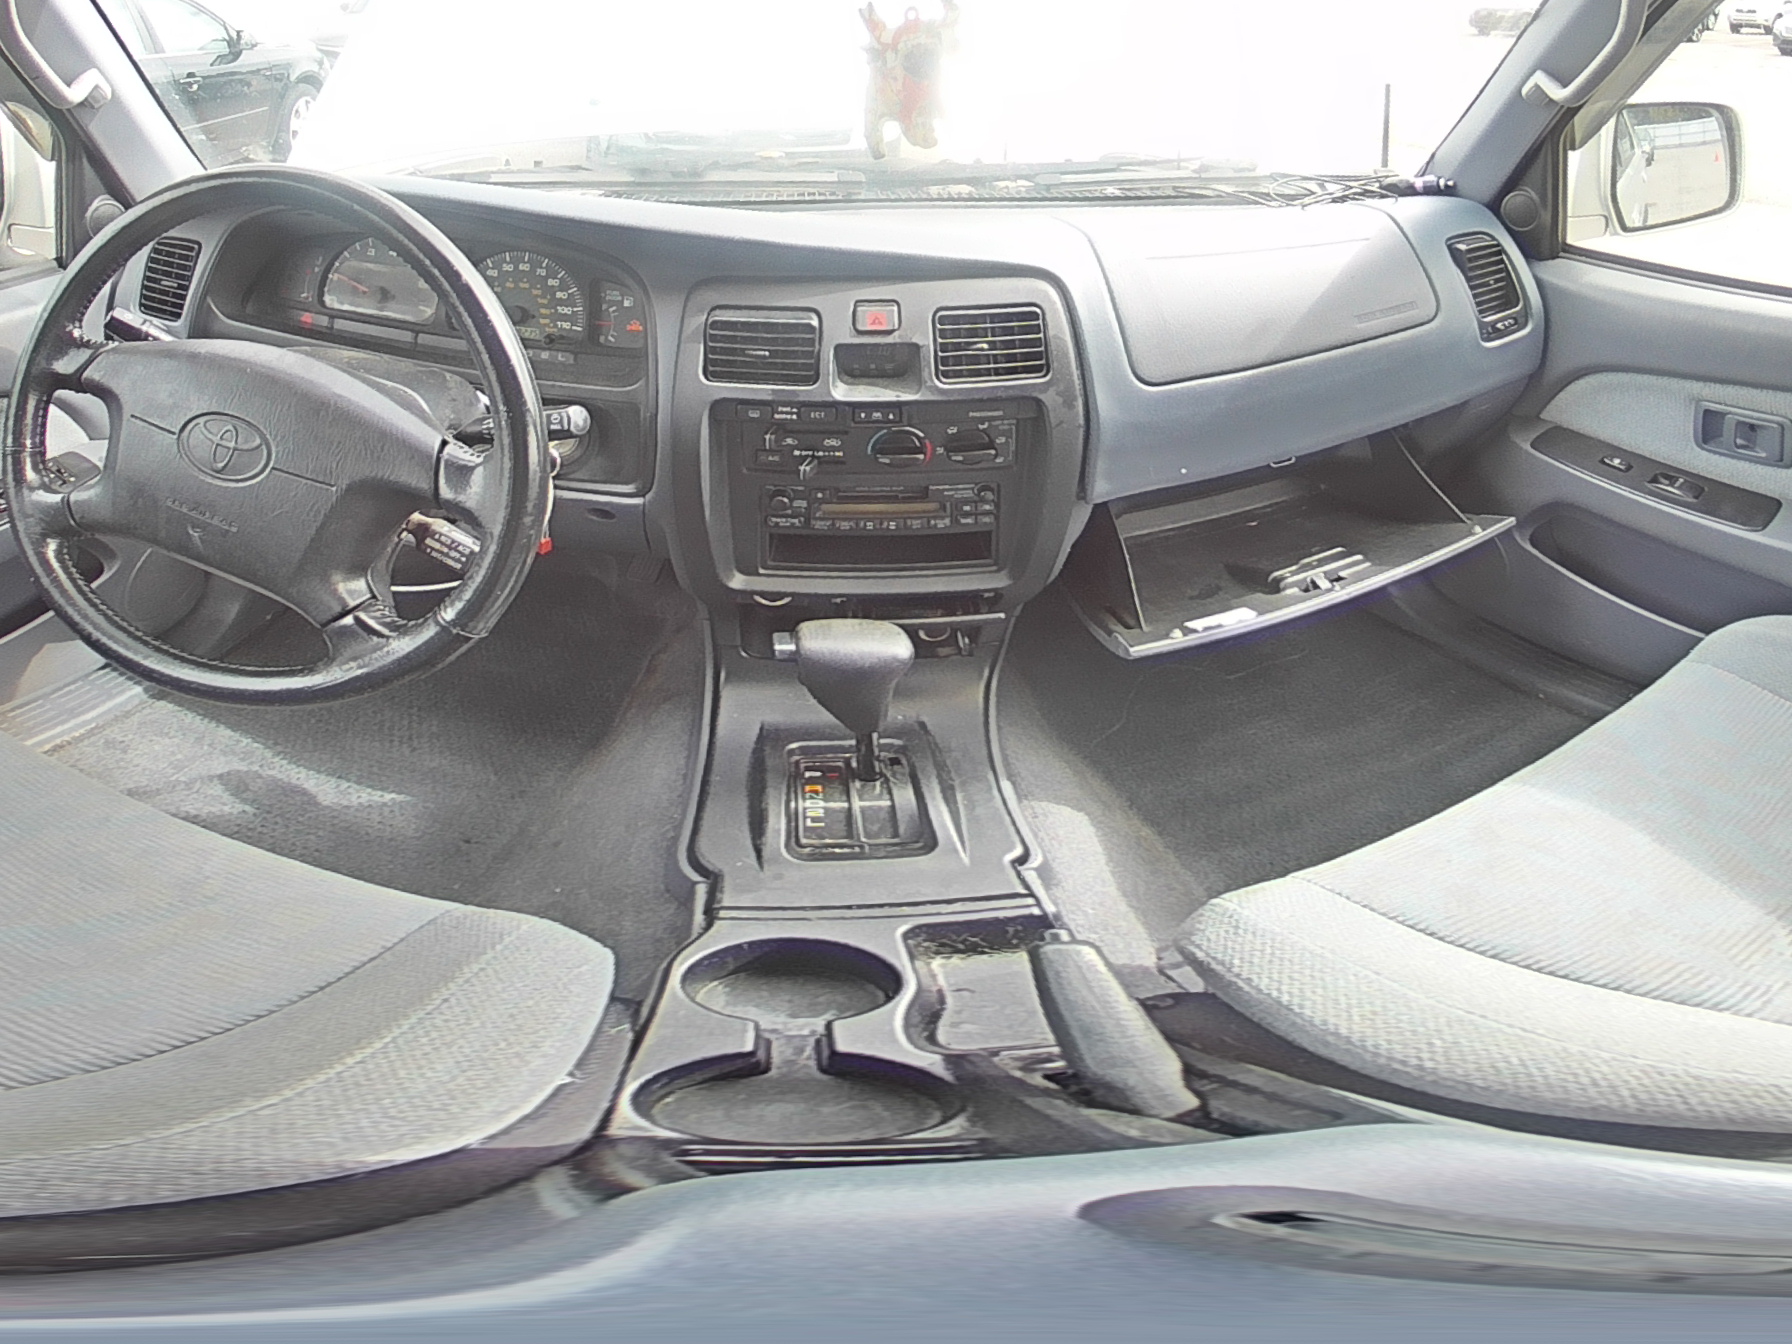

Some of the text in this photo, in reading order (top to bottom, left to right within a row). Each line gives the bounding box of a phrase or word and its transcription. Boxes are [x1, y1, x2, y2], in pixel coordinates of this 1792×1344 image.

[502, 263, 514, 271] 50
[519, 263, 530, 271] 60
[536, 268, 546, 276] 70
[548, 278, 560, 286] 80
[557, 306, 572, 314] 100
[556, 321, 571, 329] 110
